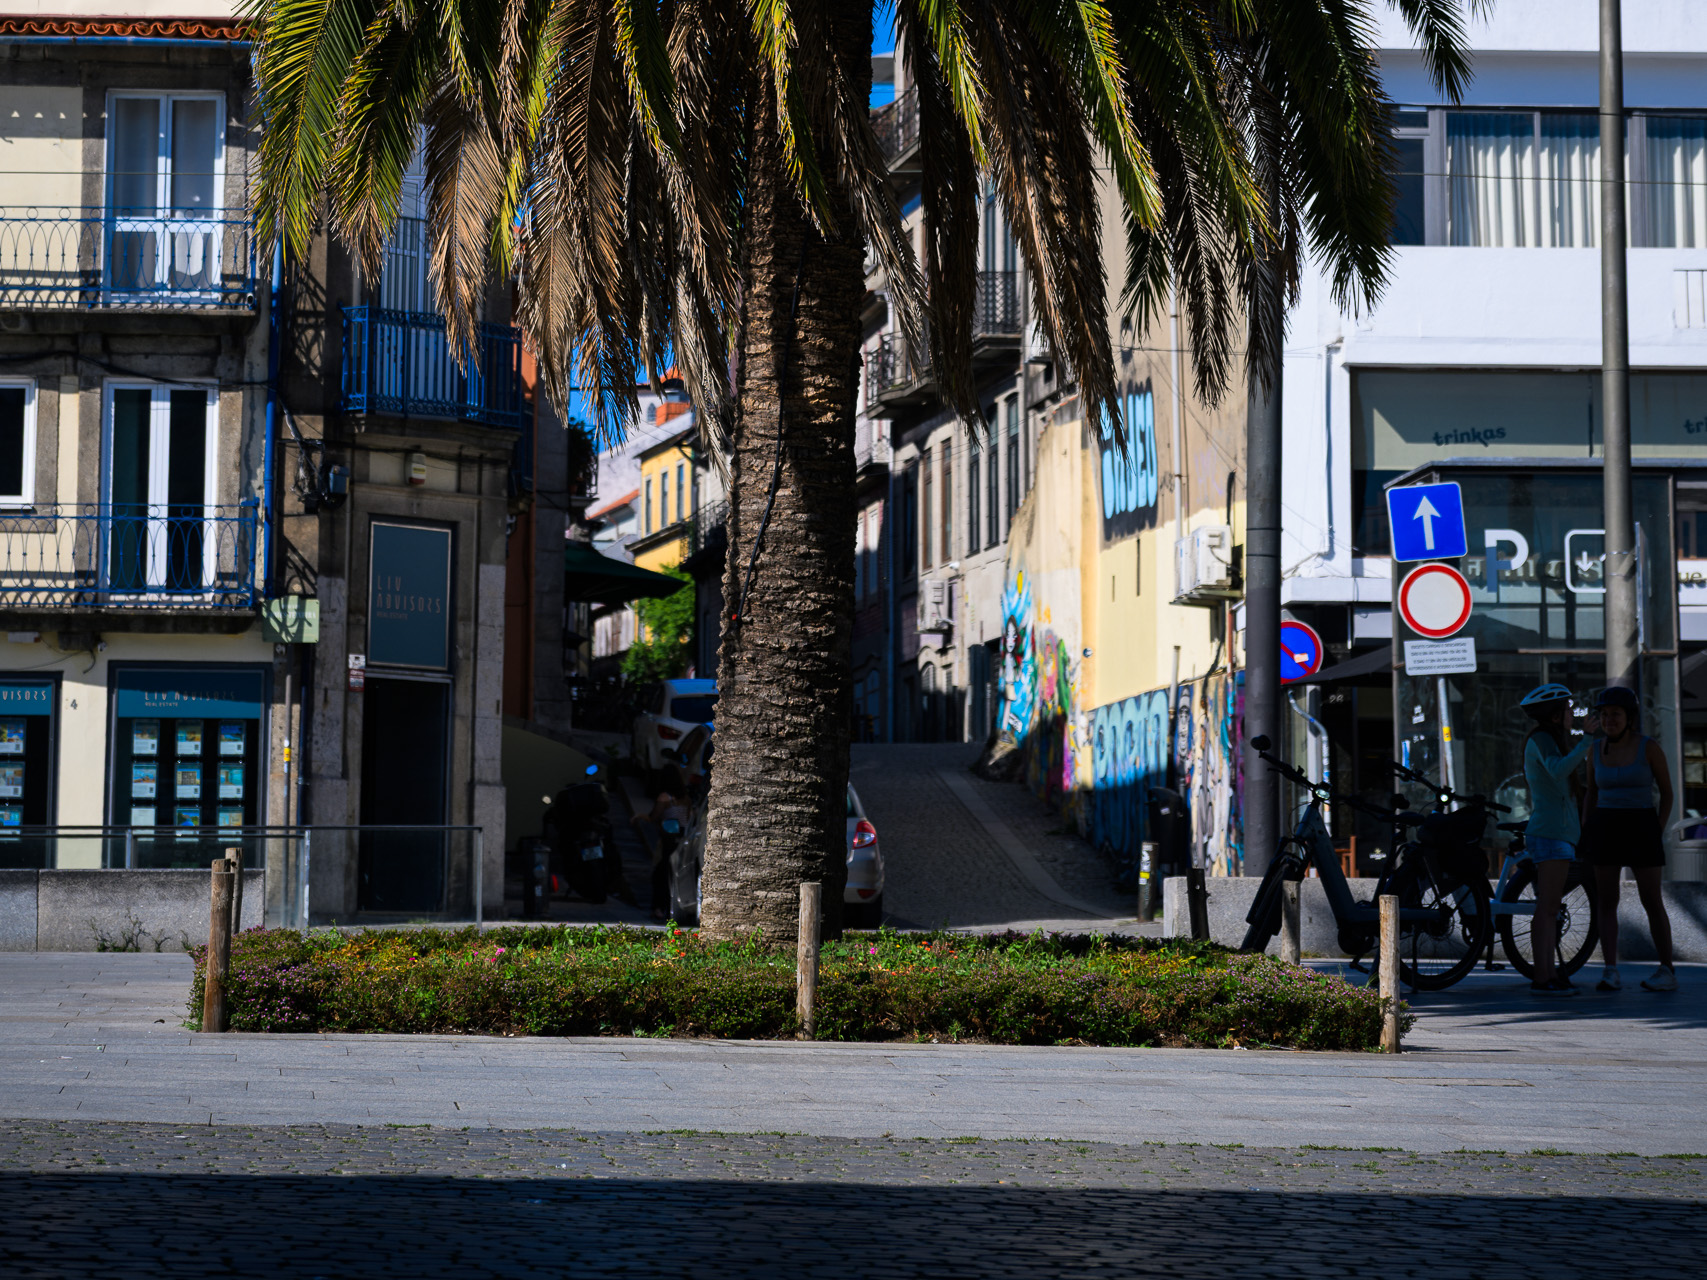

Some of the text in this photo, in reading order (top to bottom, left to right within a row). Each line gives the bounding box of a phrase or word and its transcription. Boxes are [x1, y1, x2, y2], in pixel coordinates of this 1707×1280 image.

[1433, 426, 1506, 448] trinkas
[1484, 529, 1529, 593] P
[377, 575, 401, 591] LIV
[145, 691, 167, 701] LIV
[70, 699, 78, 710] 4
